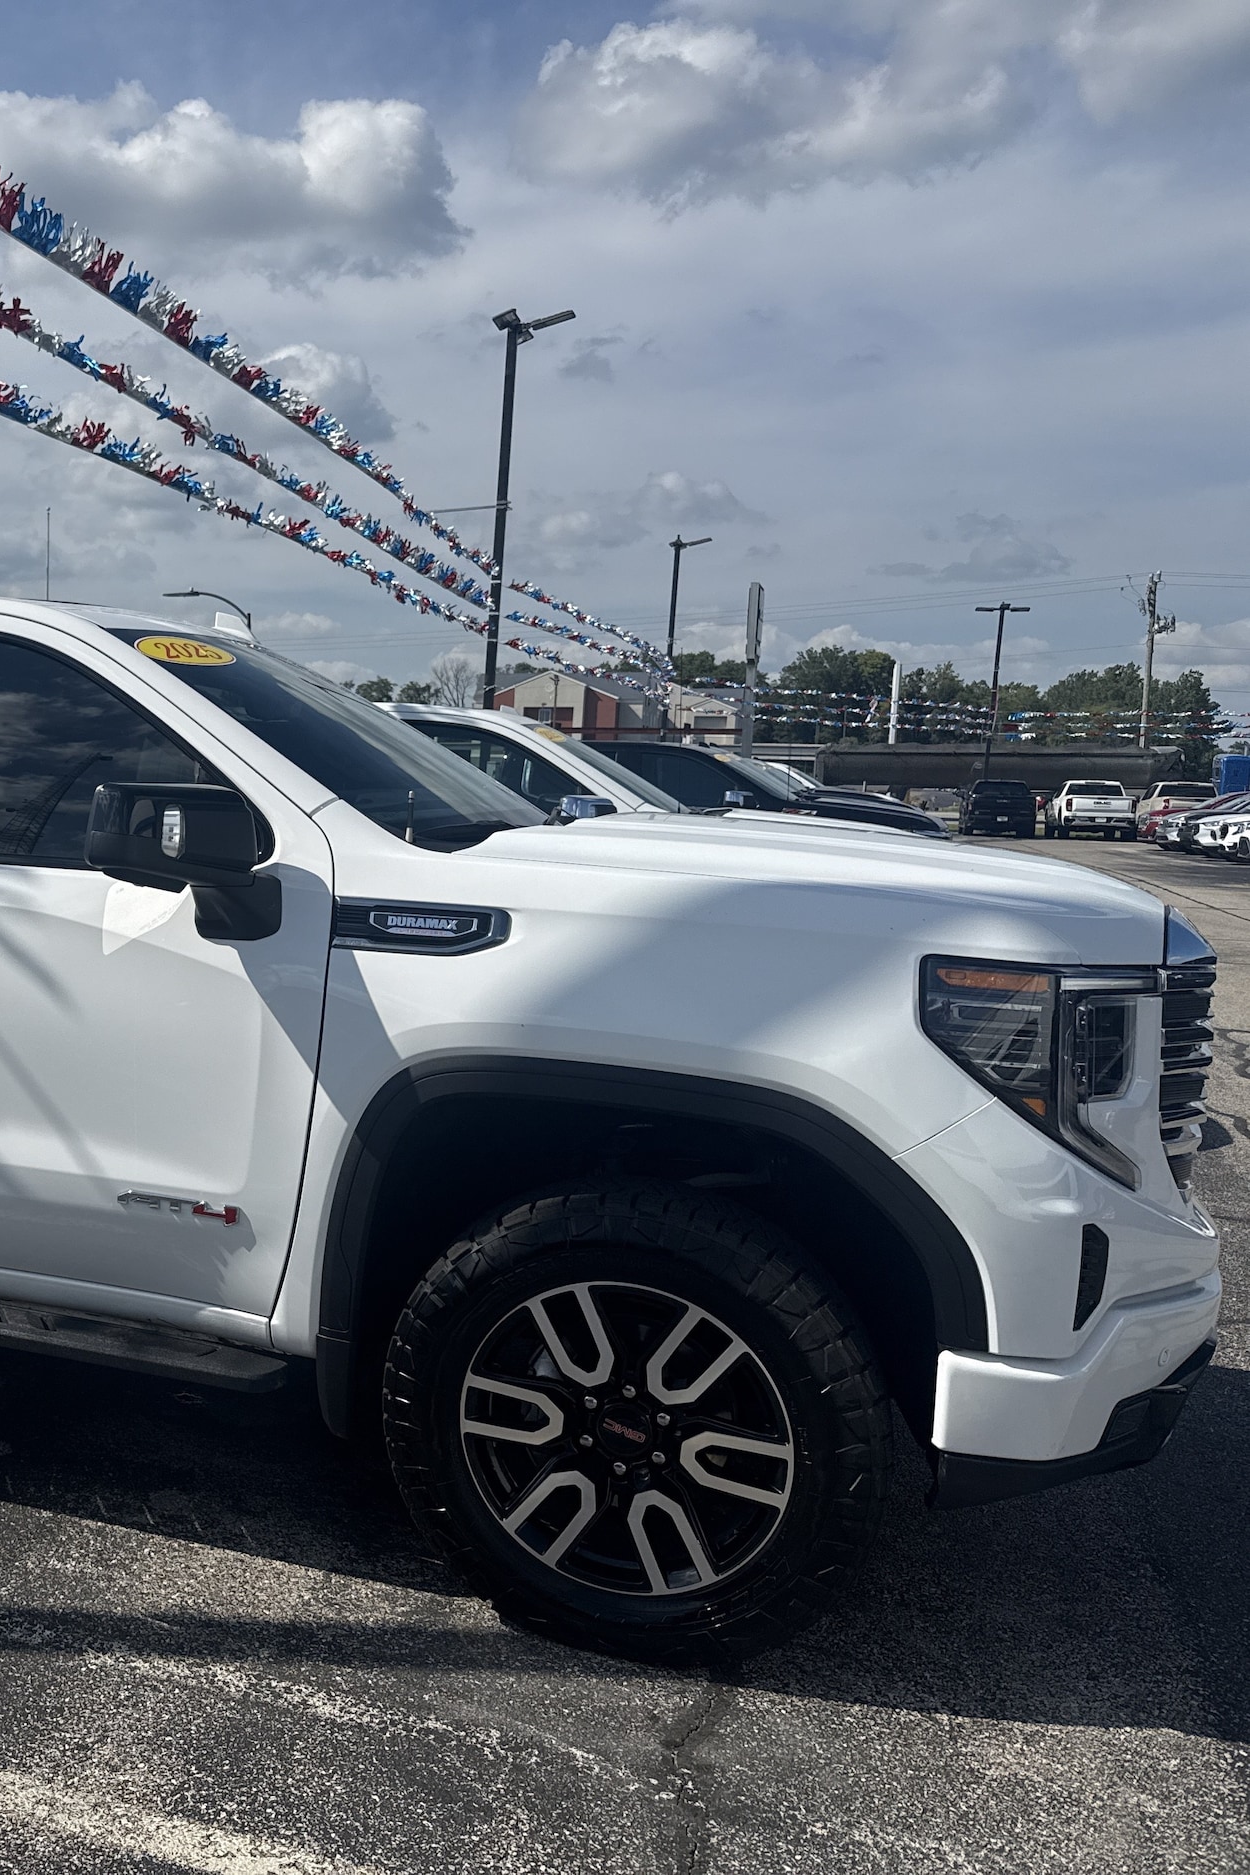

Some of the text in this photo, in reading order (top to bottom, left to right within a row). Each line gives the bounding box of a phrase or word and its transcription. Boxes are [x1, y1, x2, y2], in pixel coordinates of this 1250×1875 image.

[154, 642, 223, 660] 2025
[387, 915, 459, 931] DURAMAX
[603, 1417, 646, 1443] GMC
